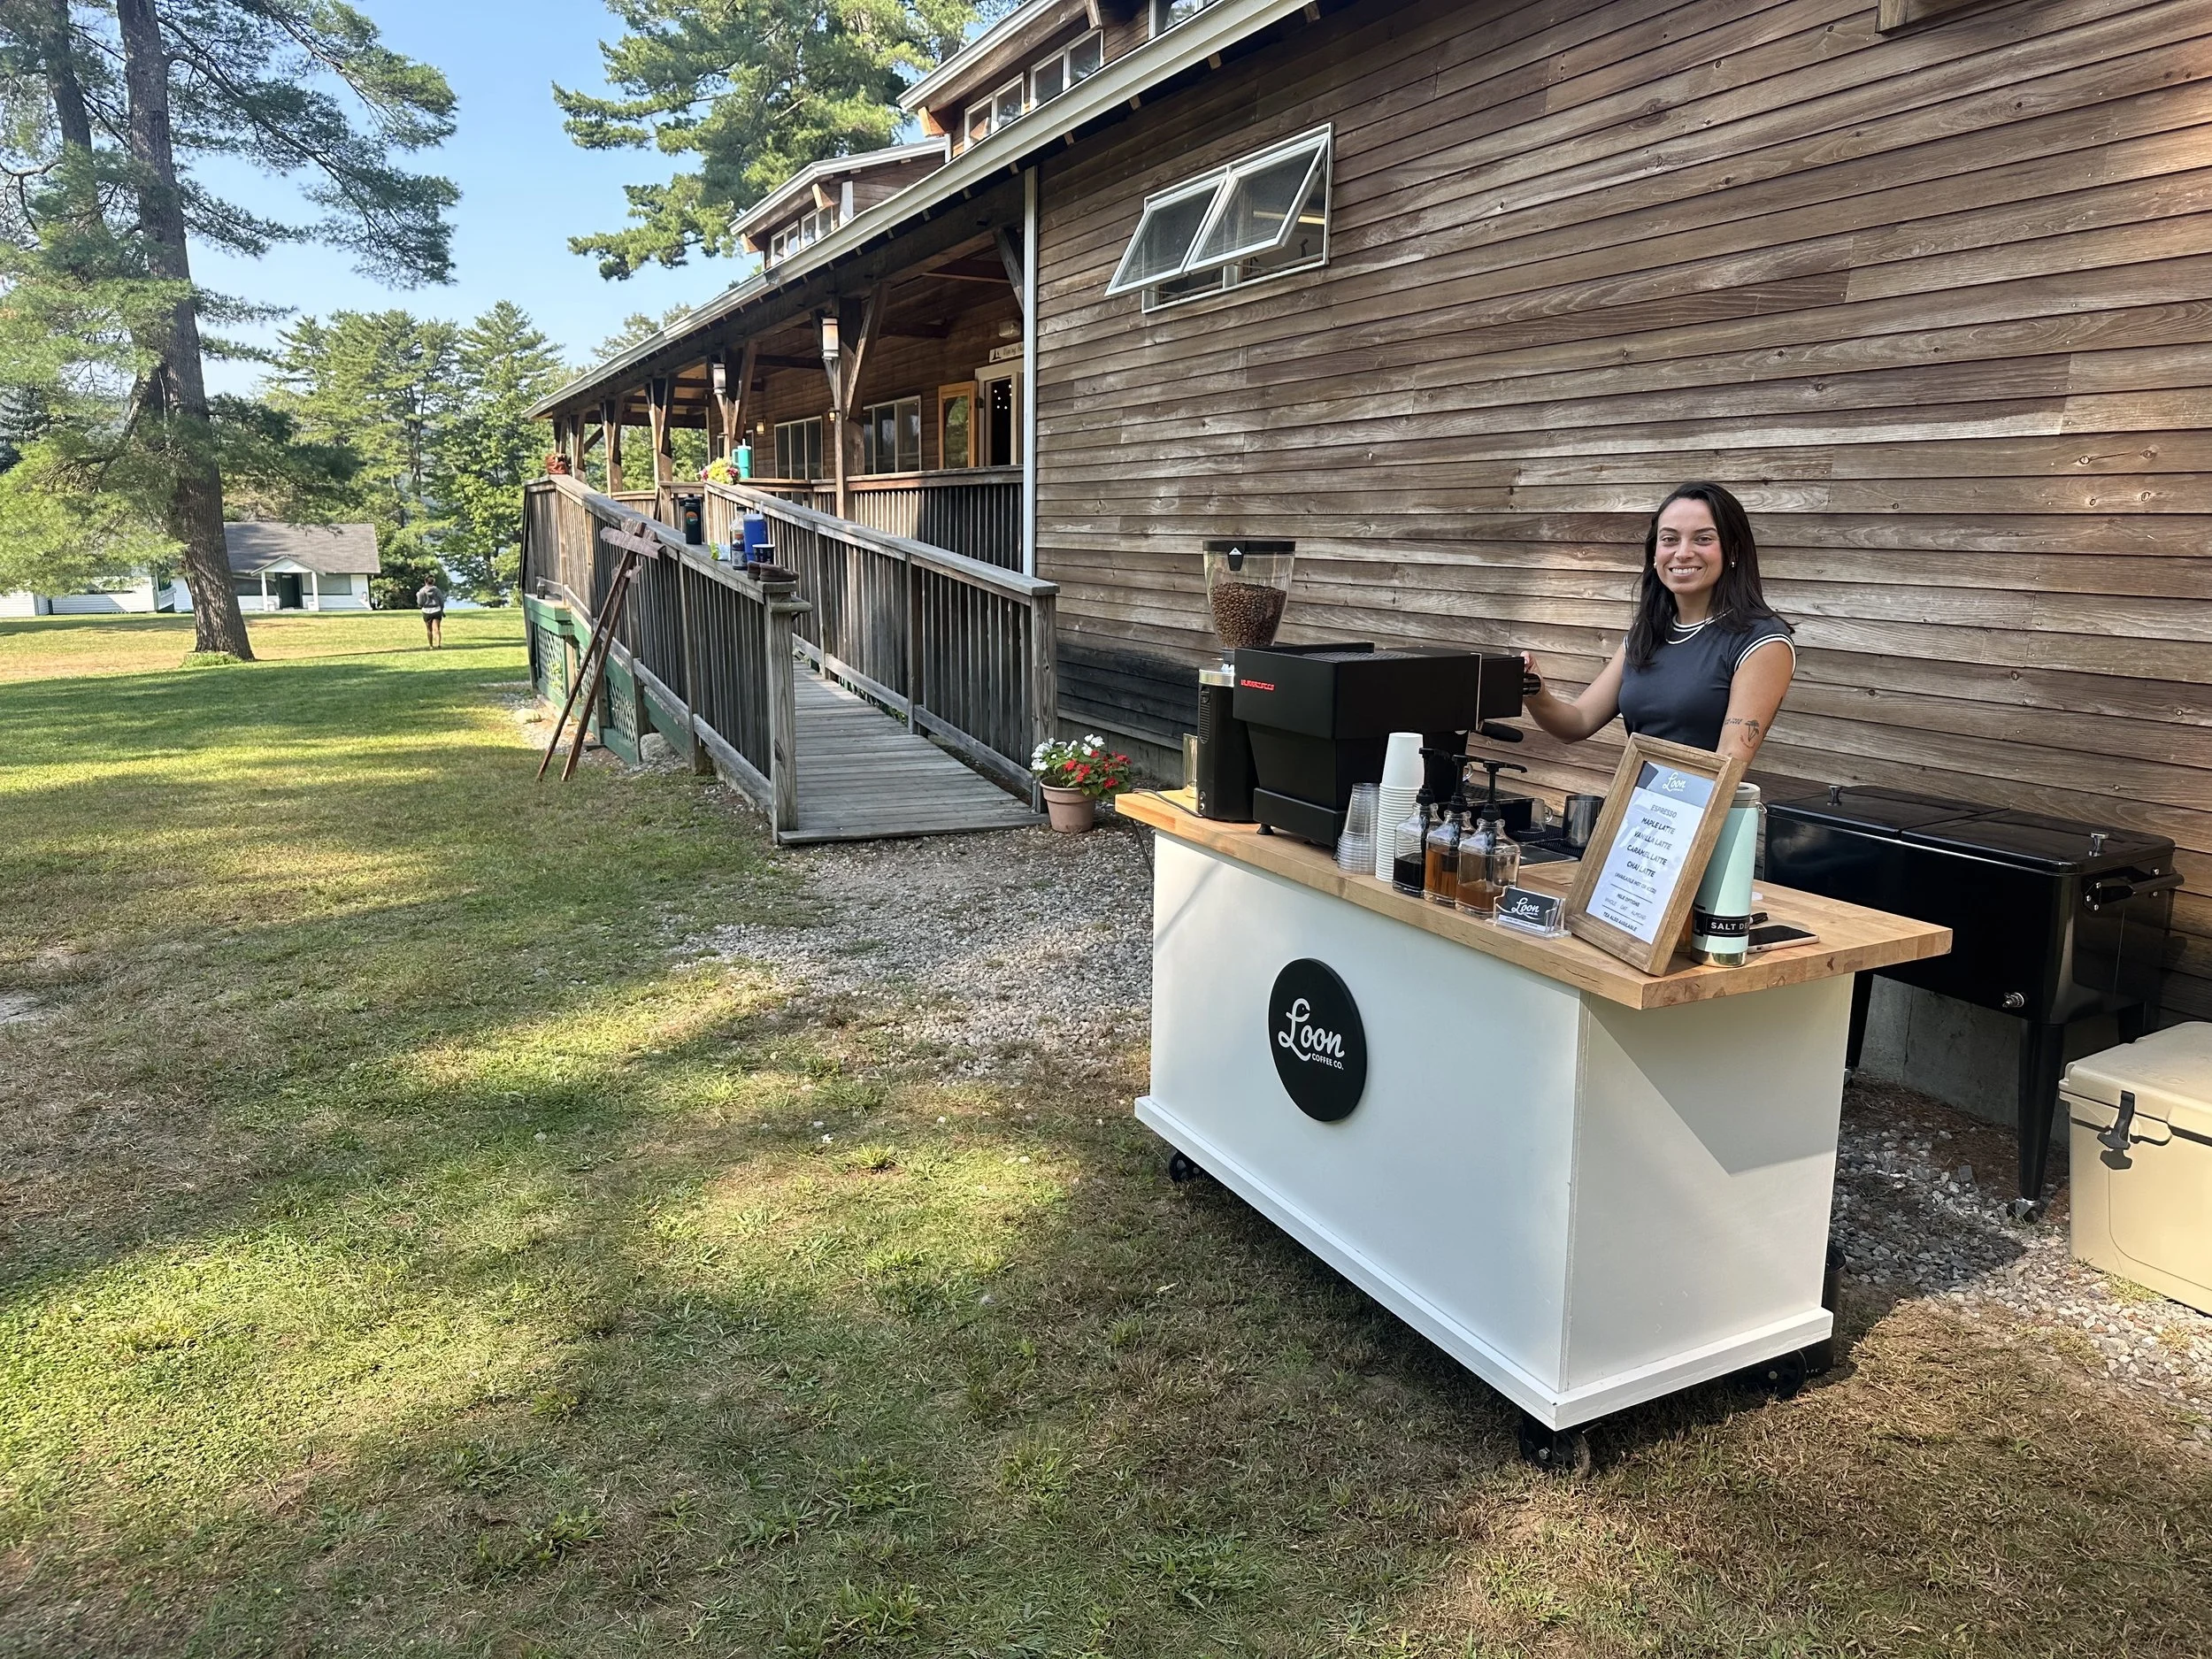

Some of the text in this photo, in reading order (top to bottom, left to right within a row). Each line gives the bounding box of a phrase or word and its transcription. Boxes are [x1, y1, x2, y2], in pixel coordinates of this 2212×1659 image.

[1663, 772, 1686, 792] Loon
[1650, 804, 1678, 818] ESPRESSO
[1641, 817, 1676, 834] MAPLE LATTE
[1633, 831, 1672, 850] VANILLA LATTE
[1626, 844, 1668, 865] CARAMEL LATTE
[1626, 861, 1656, 878] CHAI LATTE
[1510, 897, 1540, 915] Loon
[1710, 921, 1737, 931] SALT
[1278, 997, 1345, 1062] Loon
[1311, 1053, 1344, 1071] COFFEE CO.
